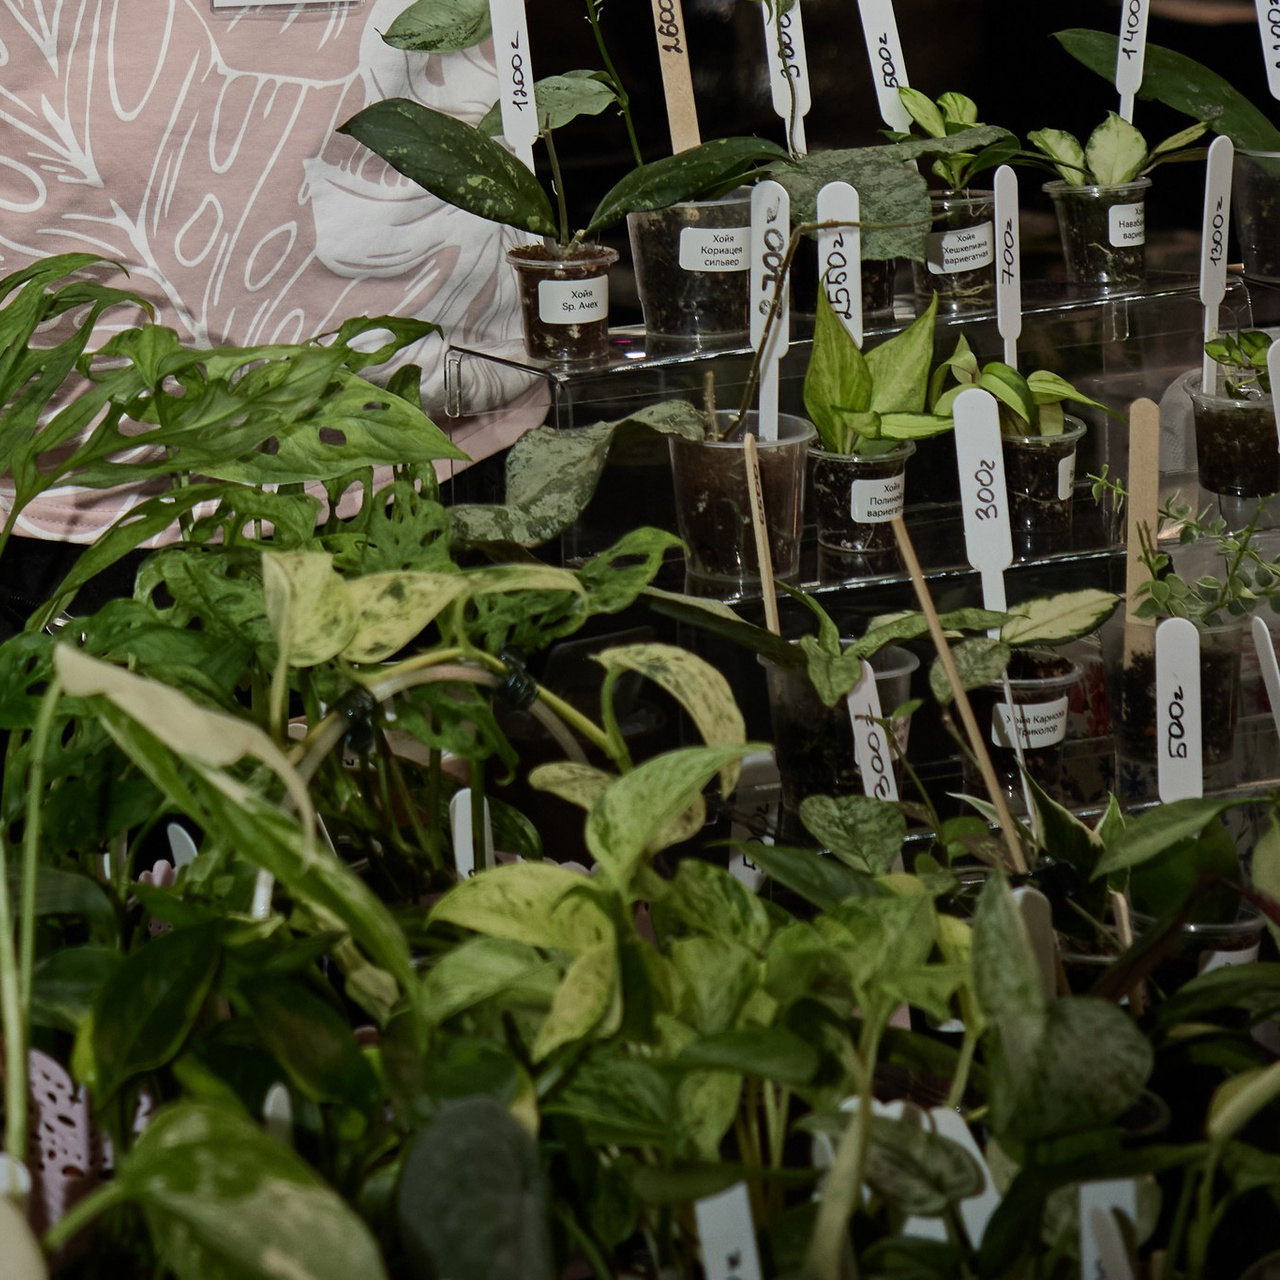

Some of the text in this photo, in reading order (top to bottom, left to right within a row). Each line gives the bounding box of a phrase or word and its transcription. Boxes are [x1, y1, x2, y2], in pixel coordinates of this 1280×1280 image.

[713, 234, 734, 243] Хойя
[956, 233, 976, 242] Хойя
[701, 246, 743, 256] Кориацея
[571, 290, 593, 299] Хойя
[562, 302, 577, 312] Sp.
